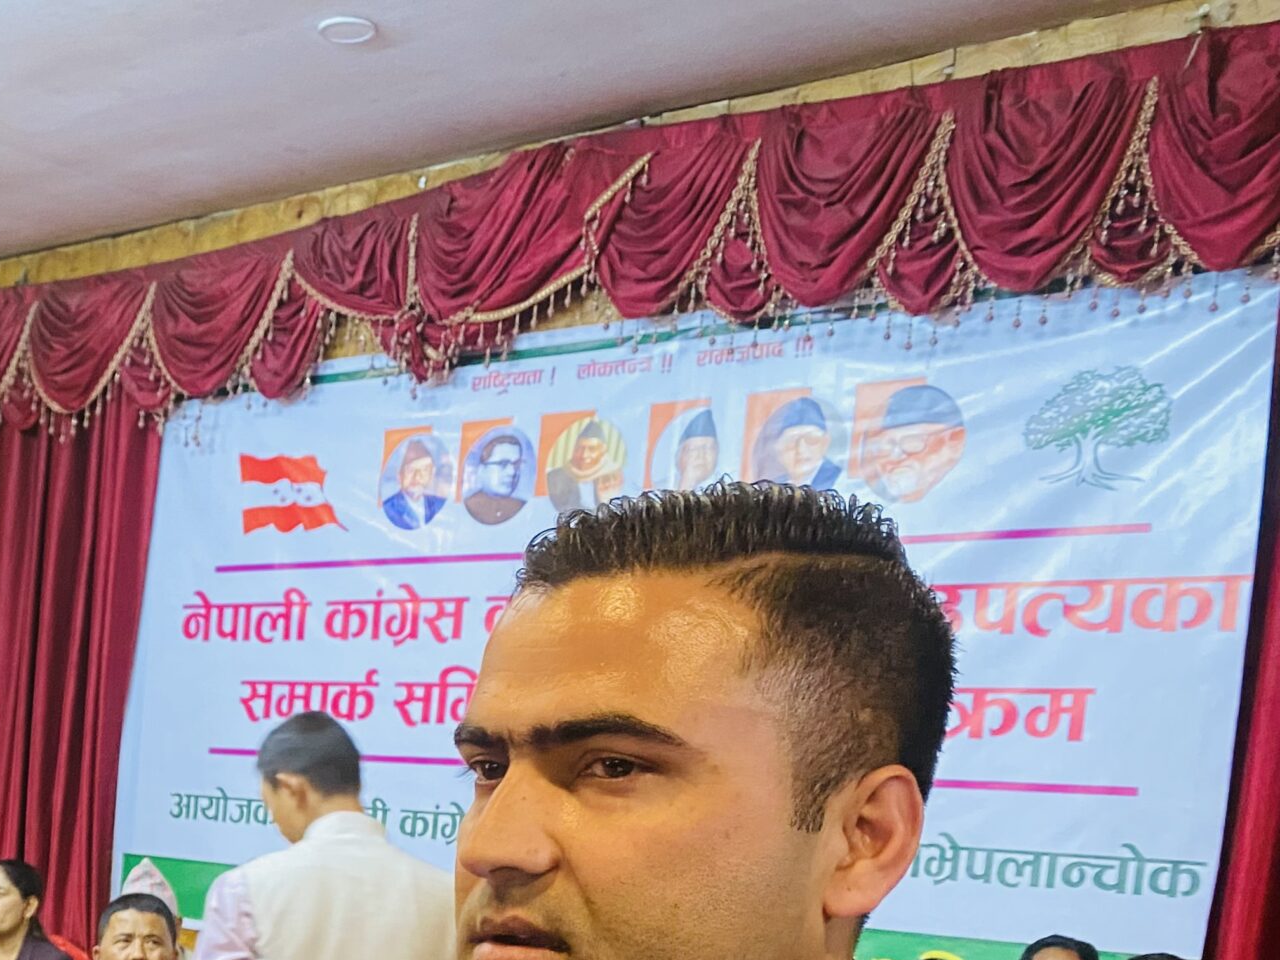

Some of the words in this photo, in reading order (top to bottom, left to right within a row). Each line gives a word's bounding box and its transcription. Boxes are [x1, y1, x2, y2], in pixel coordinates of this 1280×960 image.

[576, 356, 654, 380] लोकतन्त्र
[182, 588, 310, 643] नेपाली
[324, 583, 470, 647] कांग्रेस
[399, 801, 465, 845] कांग्रे
